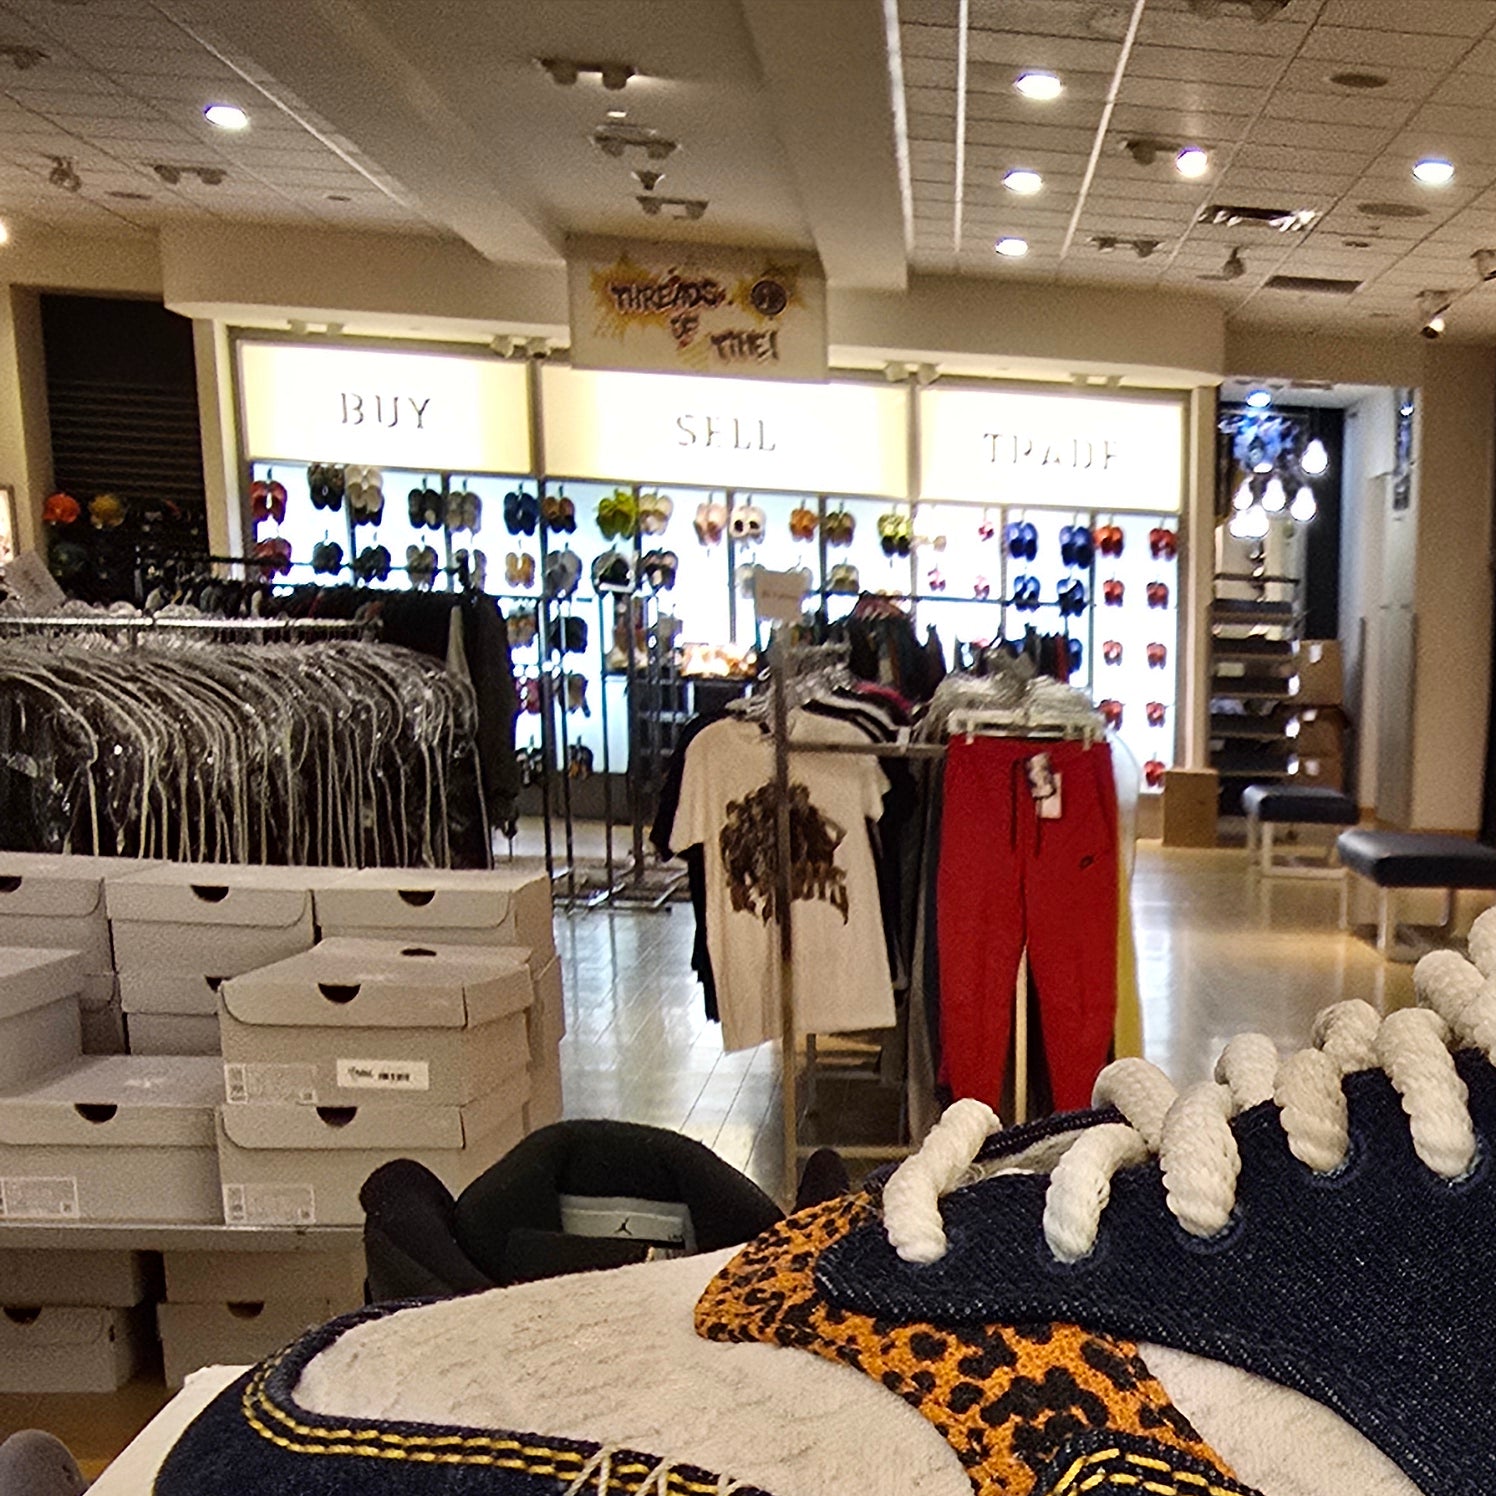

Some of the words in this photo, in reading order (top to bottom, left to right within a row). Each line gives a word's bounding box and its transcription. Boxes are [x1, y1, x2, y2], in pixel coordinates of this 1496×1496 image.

[340, 391, 432, 430] BUY
[675, 414, 777, 452] SELL
[982, 432, 1119, 470] TRADE
